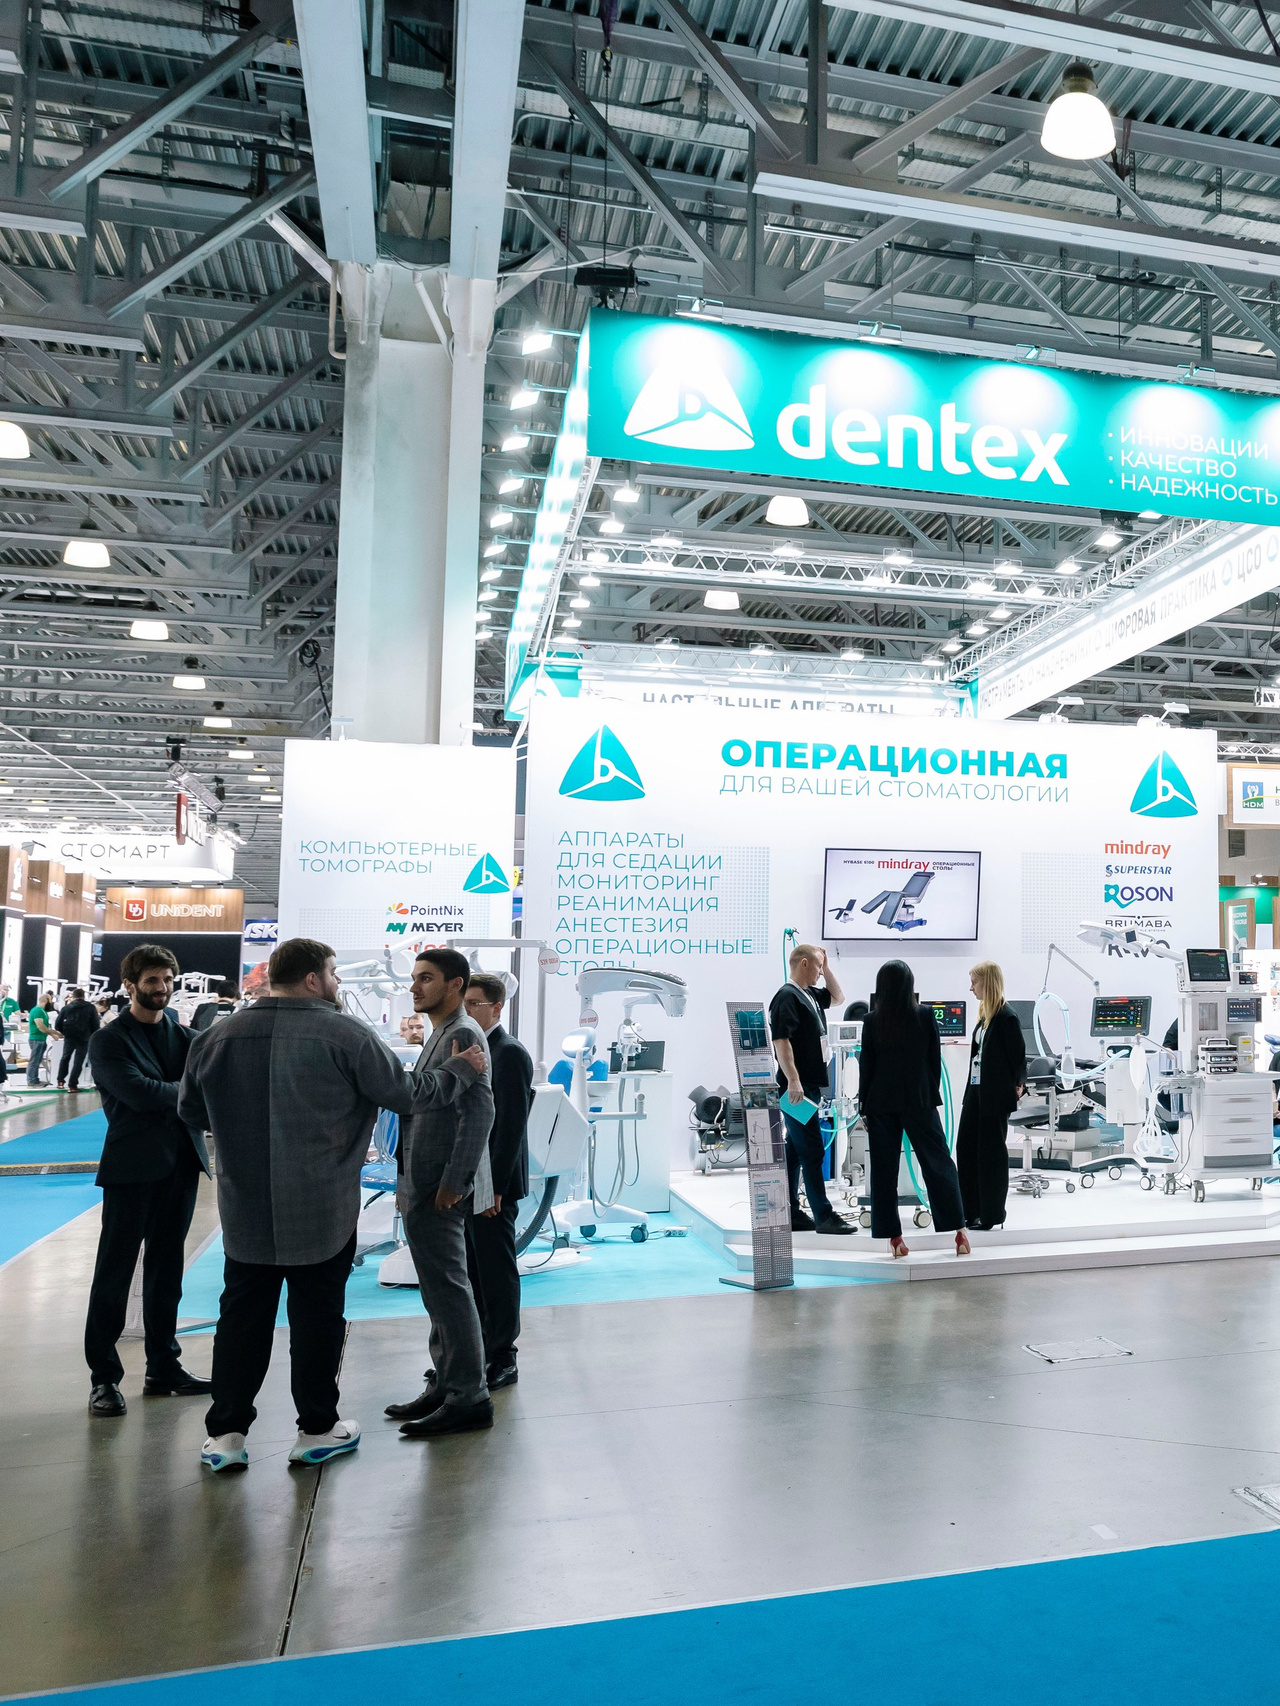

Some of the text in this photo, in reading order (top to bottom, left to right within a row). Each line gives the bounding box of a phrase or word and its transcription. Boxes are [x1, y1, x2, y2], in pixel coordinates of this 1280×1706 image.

[776, 383, 1071, 486] dentex
[1120, 425, 1270, 460] ИННОВАЦИИ
[1120, 449, 1237, 479] КАЧЕСТВО
[1120, 472, 1279, 506] НАДЕЖНОСТЬ
[1105, 602, 1157, 648] ЦИФРОВАЯ
[1160, 568, 1218, 621] ПРАКТИКА
[1237, 543, 1263, 583] ЦСО
[721, 738, 1068, 779] ОПЕРАЦИОННАЯ
[719, 774, 1069, 803] ДЛЯ ВАШЕЙ СТОМАТОЛОГИИ
[300, 840, 478, 857] КОМПЬЮТЕРНЫЕ
[557, 830, 684, 849] АППАРАТЫ
[1105, 840, 1171, 859] mindray
[298, 858, 433, 875] ТОМОГРАФЫ
[556, 852, 722, 873] ДЛЯ СЕДАЦИИ
[877, 858, 930, 873] mindray
[1114, 865, 1172, 875] SUPERSTAR
[557, 874, 720, 891] МОНИТОРИНГ
[557, 895, 719, 915] РЕАНИМАЦИЯ
[1104, 884, 1173, 909] ROSON
[410, 905, 464, 916] PointNix
[411, 922, 463, 933] MEYER
[555, 917, 689, 933] АНЕСТЕЗИЯ
[555, 938, 753, 957] ОПЕРАЦИОННЫЕ
